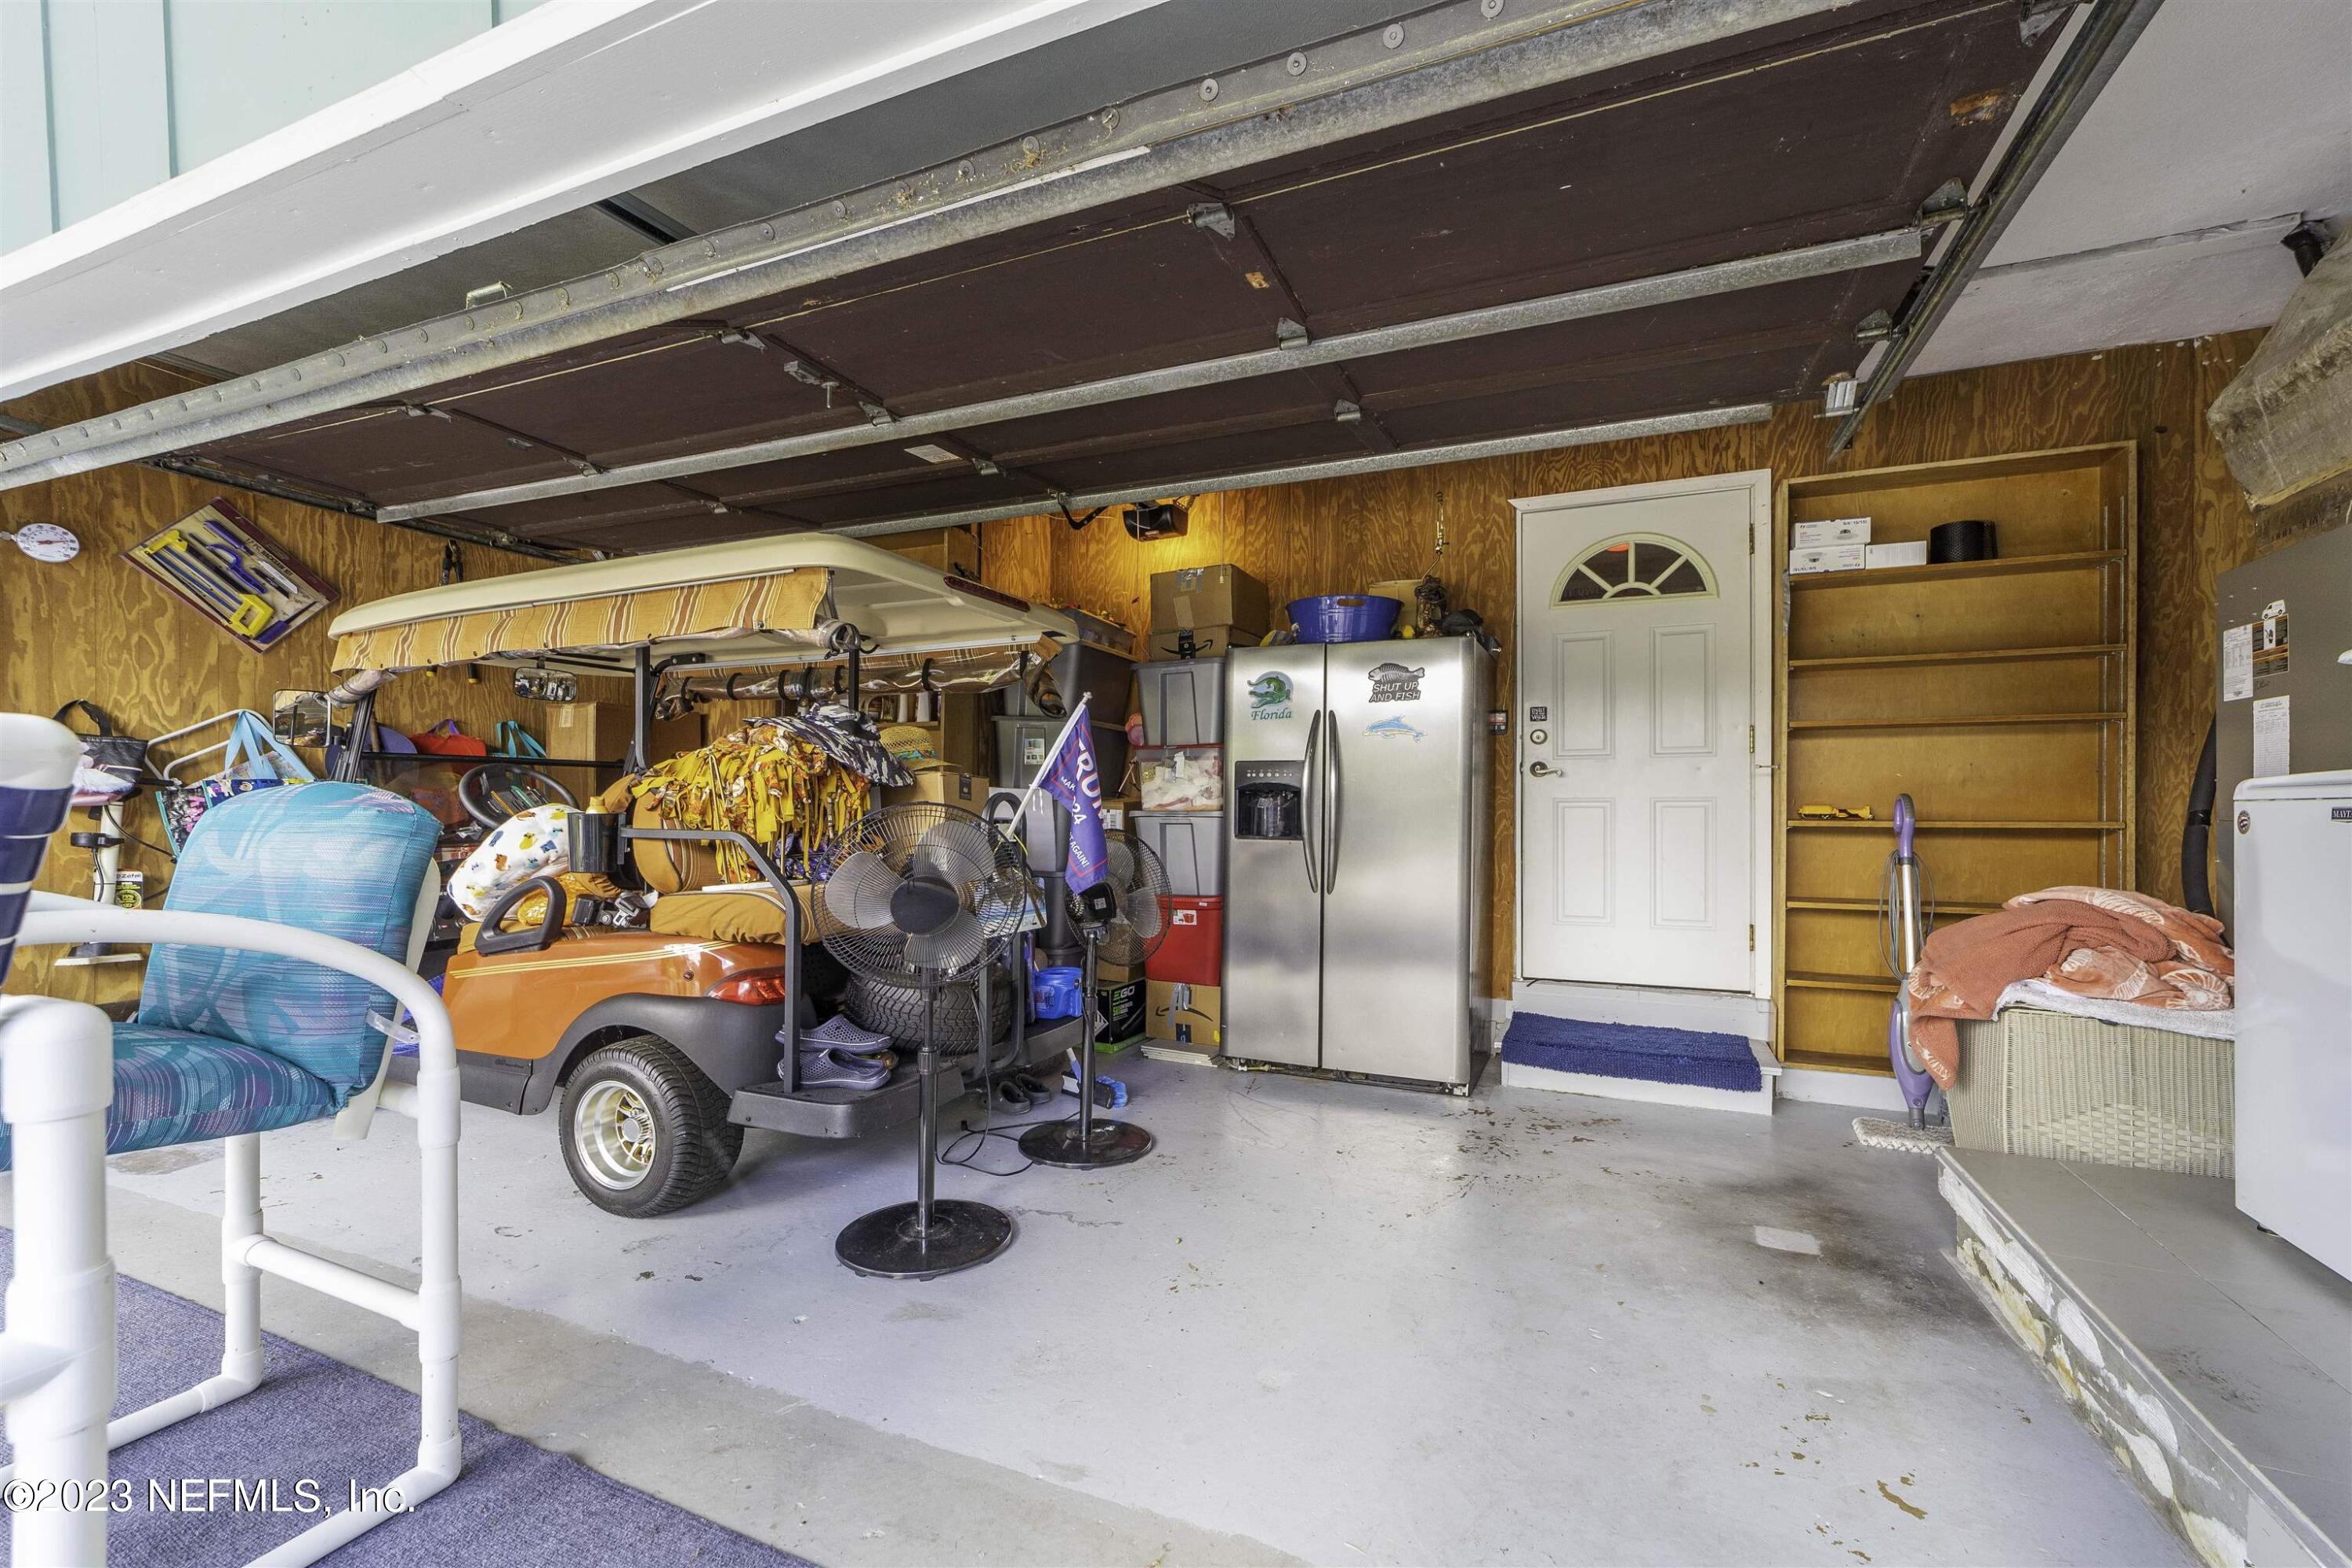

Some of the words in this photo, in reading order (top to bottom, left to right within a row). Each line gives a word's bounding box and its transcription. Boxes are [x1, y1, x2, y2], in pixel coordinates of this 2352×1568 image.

[1373, 683, 1402, 692] SHUT
[1404, 681, 1418, 691] UP
[1370, 693, 1392, 702] AND
[1396, 691, 1420, 700] FISH
[1251, 707, 1292, 720] Florida
[1069, 840, 1090, 868] AGAIN!
[1113, 985, 1135, 1000] EGO
